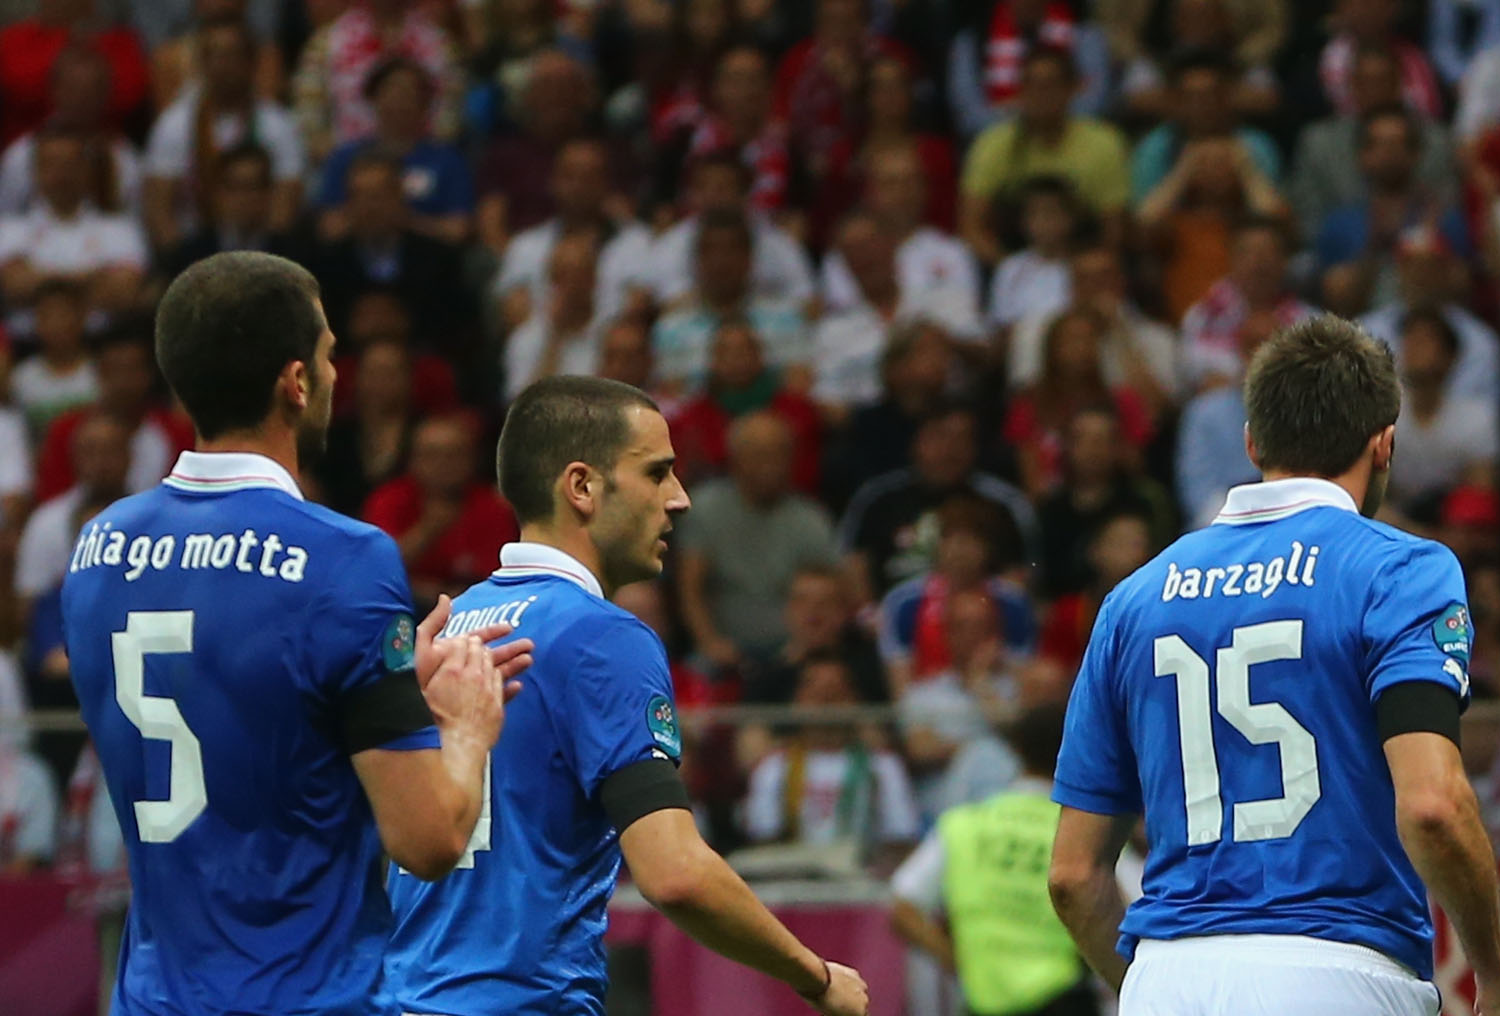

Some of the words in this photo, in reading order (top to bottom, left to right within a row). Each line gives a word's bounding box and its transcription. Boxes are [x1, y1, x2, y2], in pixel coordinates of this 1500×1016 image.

[70, 521, 175, 582] thiago
[181, 528, 309, 582] motta
[1161, 540, 1320, 602] barzagli
[434, 595, 538, 640] onucci
[111, 609, 208, 844] 5
[1154, 619, 1322, 847] 15
